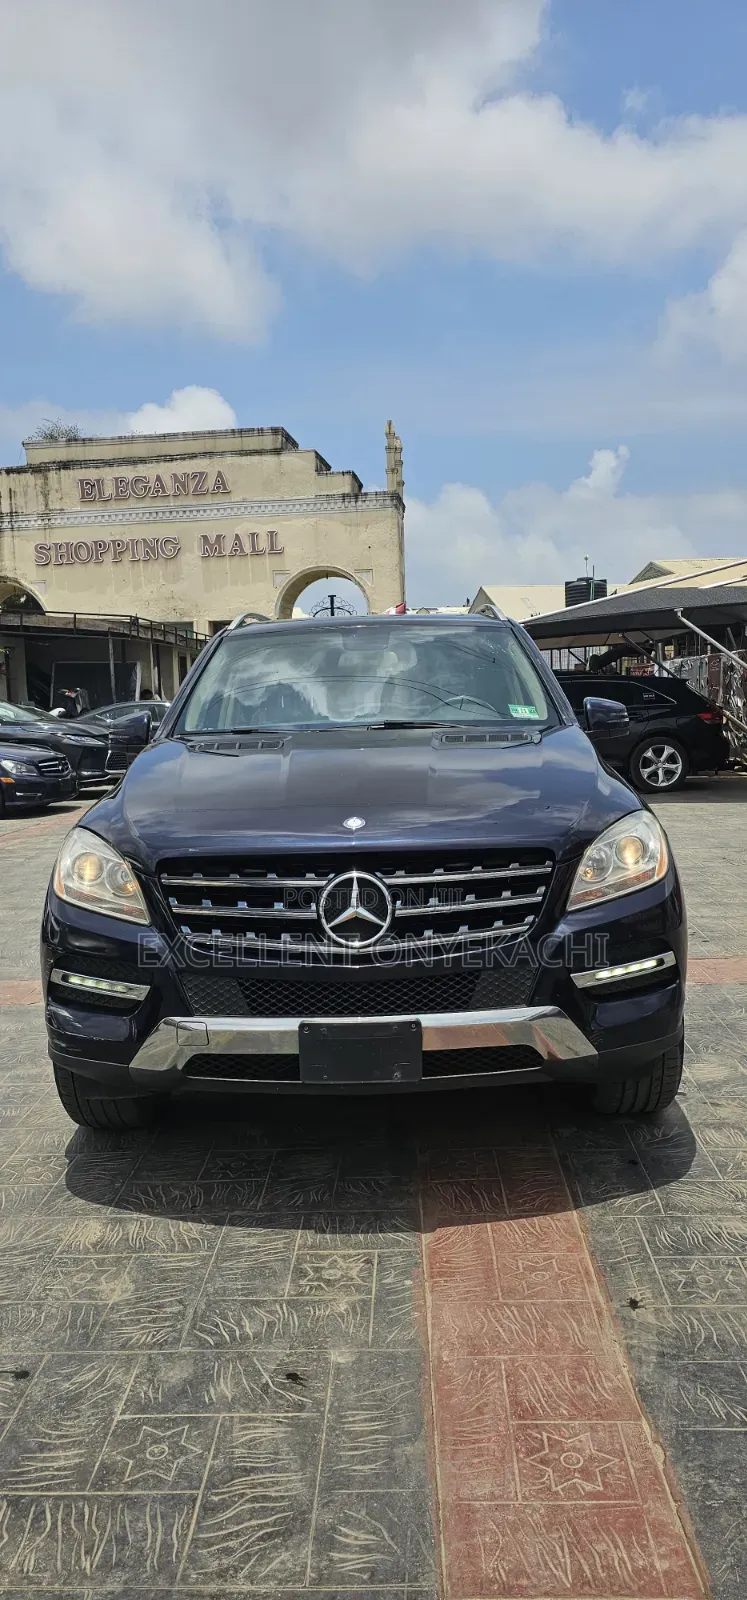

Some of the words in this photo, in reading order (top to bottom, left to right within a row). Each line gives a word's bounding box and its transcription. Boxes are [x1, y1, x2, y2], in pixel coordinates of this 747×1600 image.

[77, 470, 232, 502] ELEGANZA
[33, 535, 182, 566] SHOPPING
[199, 530, 285, 558] MALL
